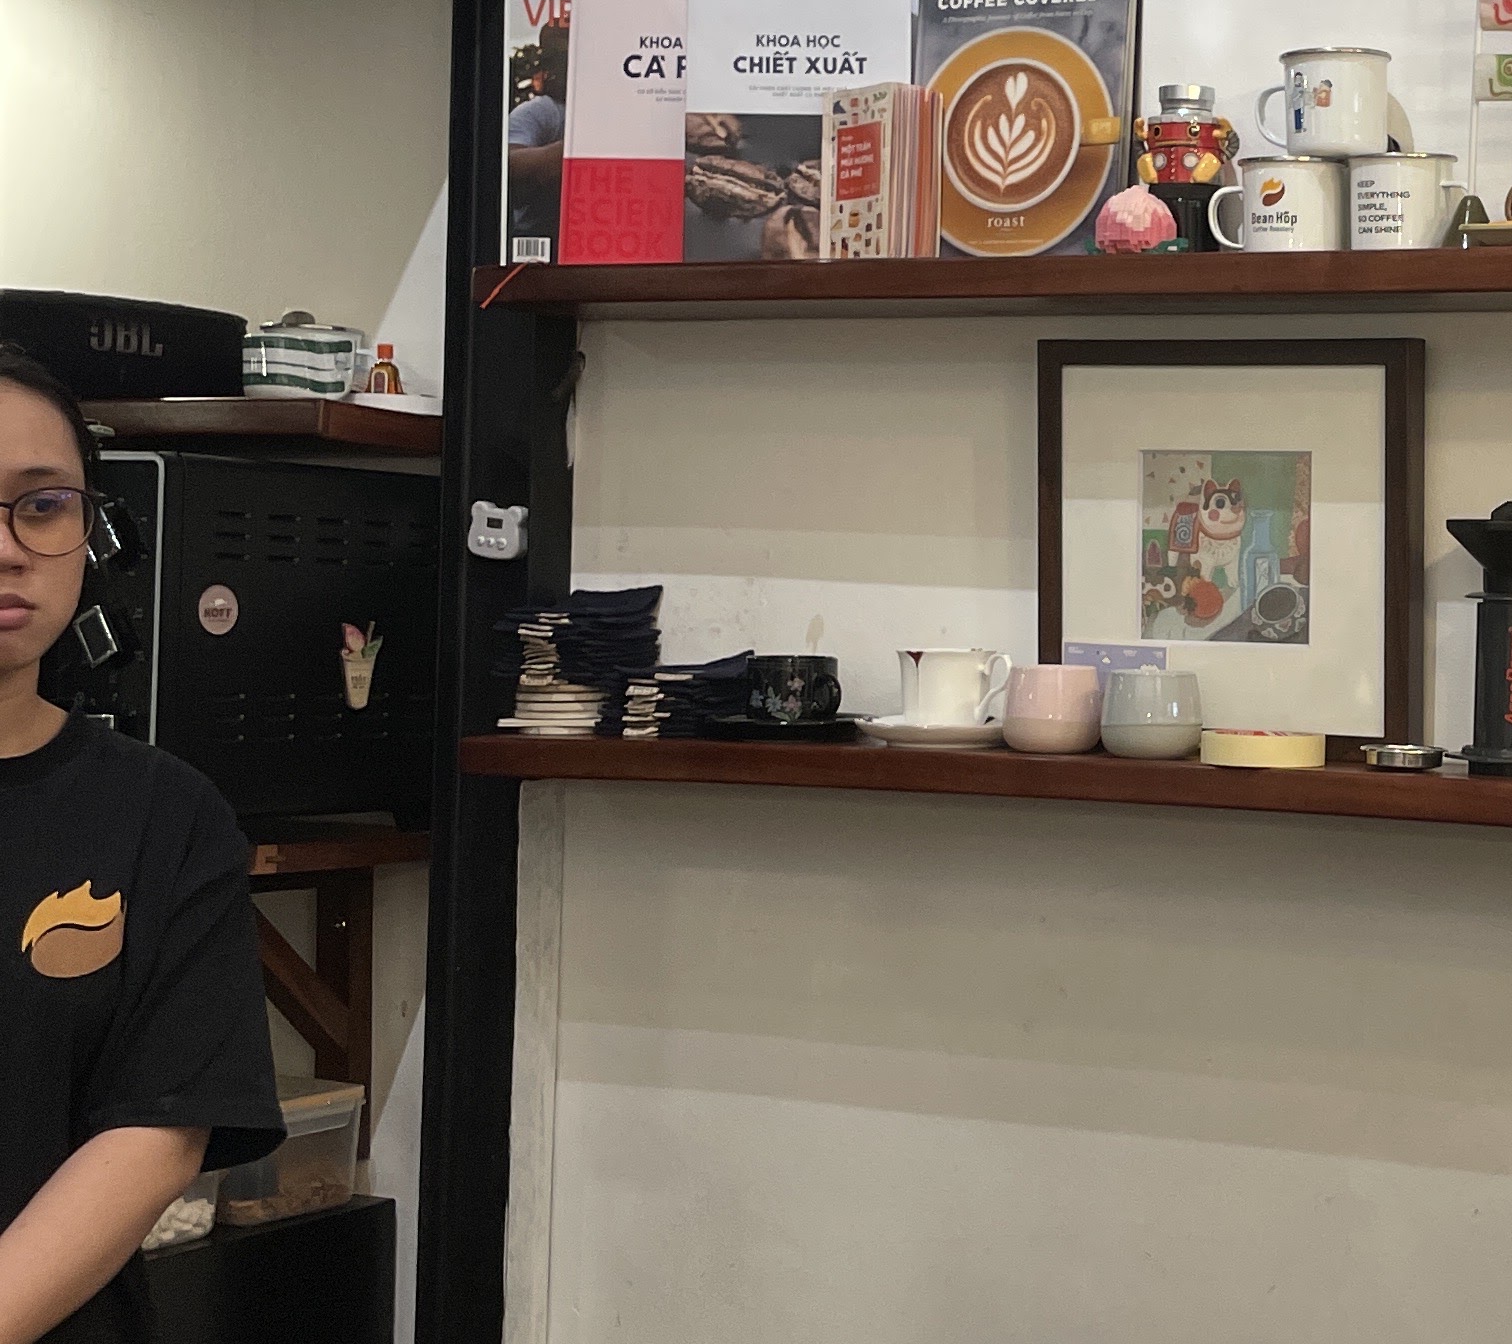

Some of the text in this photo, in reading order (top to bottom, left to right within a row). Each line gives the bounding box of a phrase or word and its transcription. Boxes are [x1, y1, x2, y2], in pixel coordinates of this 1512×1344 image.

[639, 35, 683, 50] KHOA
[756, 34, 841, 50] KHOA HỌC
[733, 51, 868, 75] CHIẾT XUẤT
[987, 215, 1025, 228] roast
[1251, 212, 1274, 225] Bean
[1368, 214, 1404, 223] COFFEE
[89, 318, 163, 356] JBL
